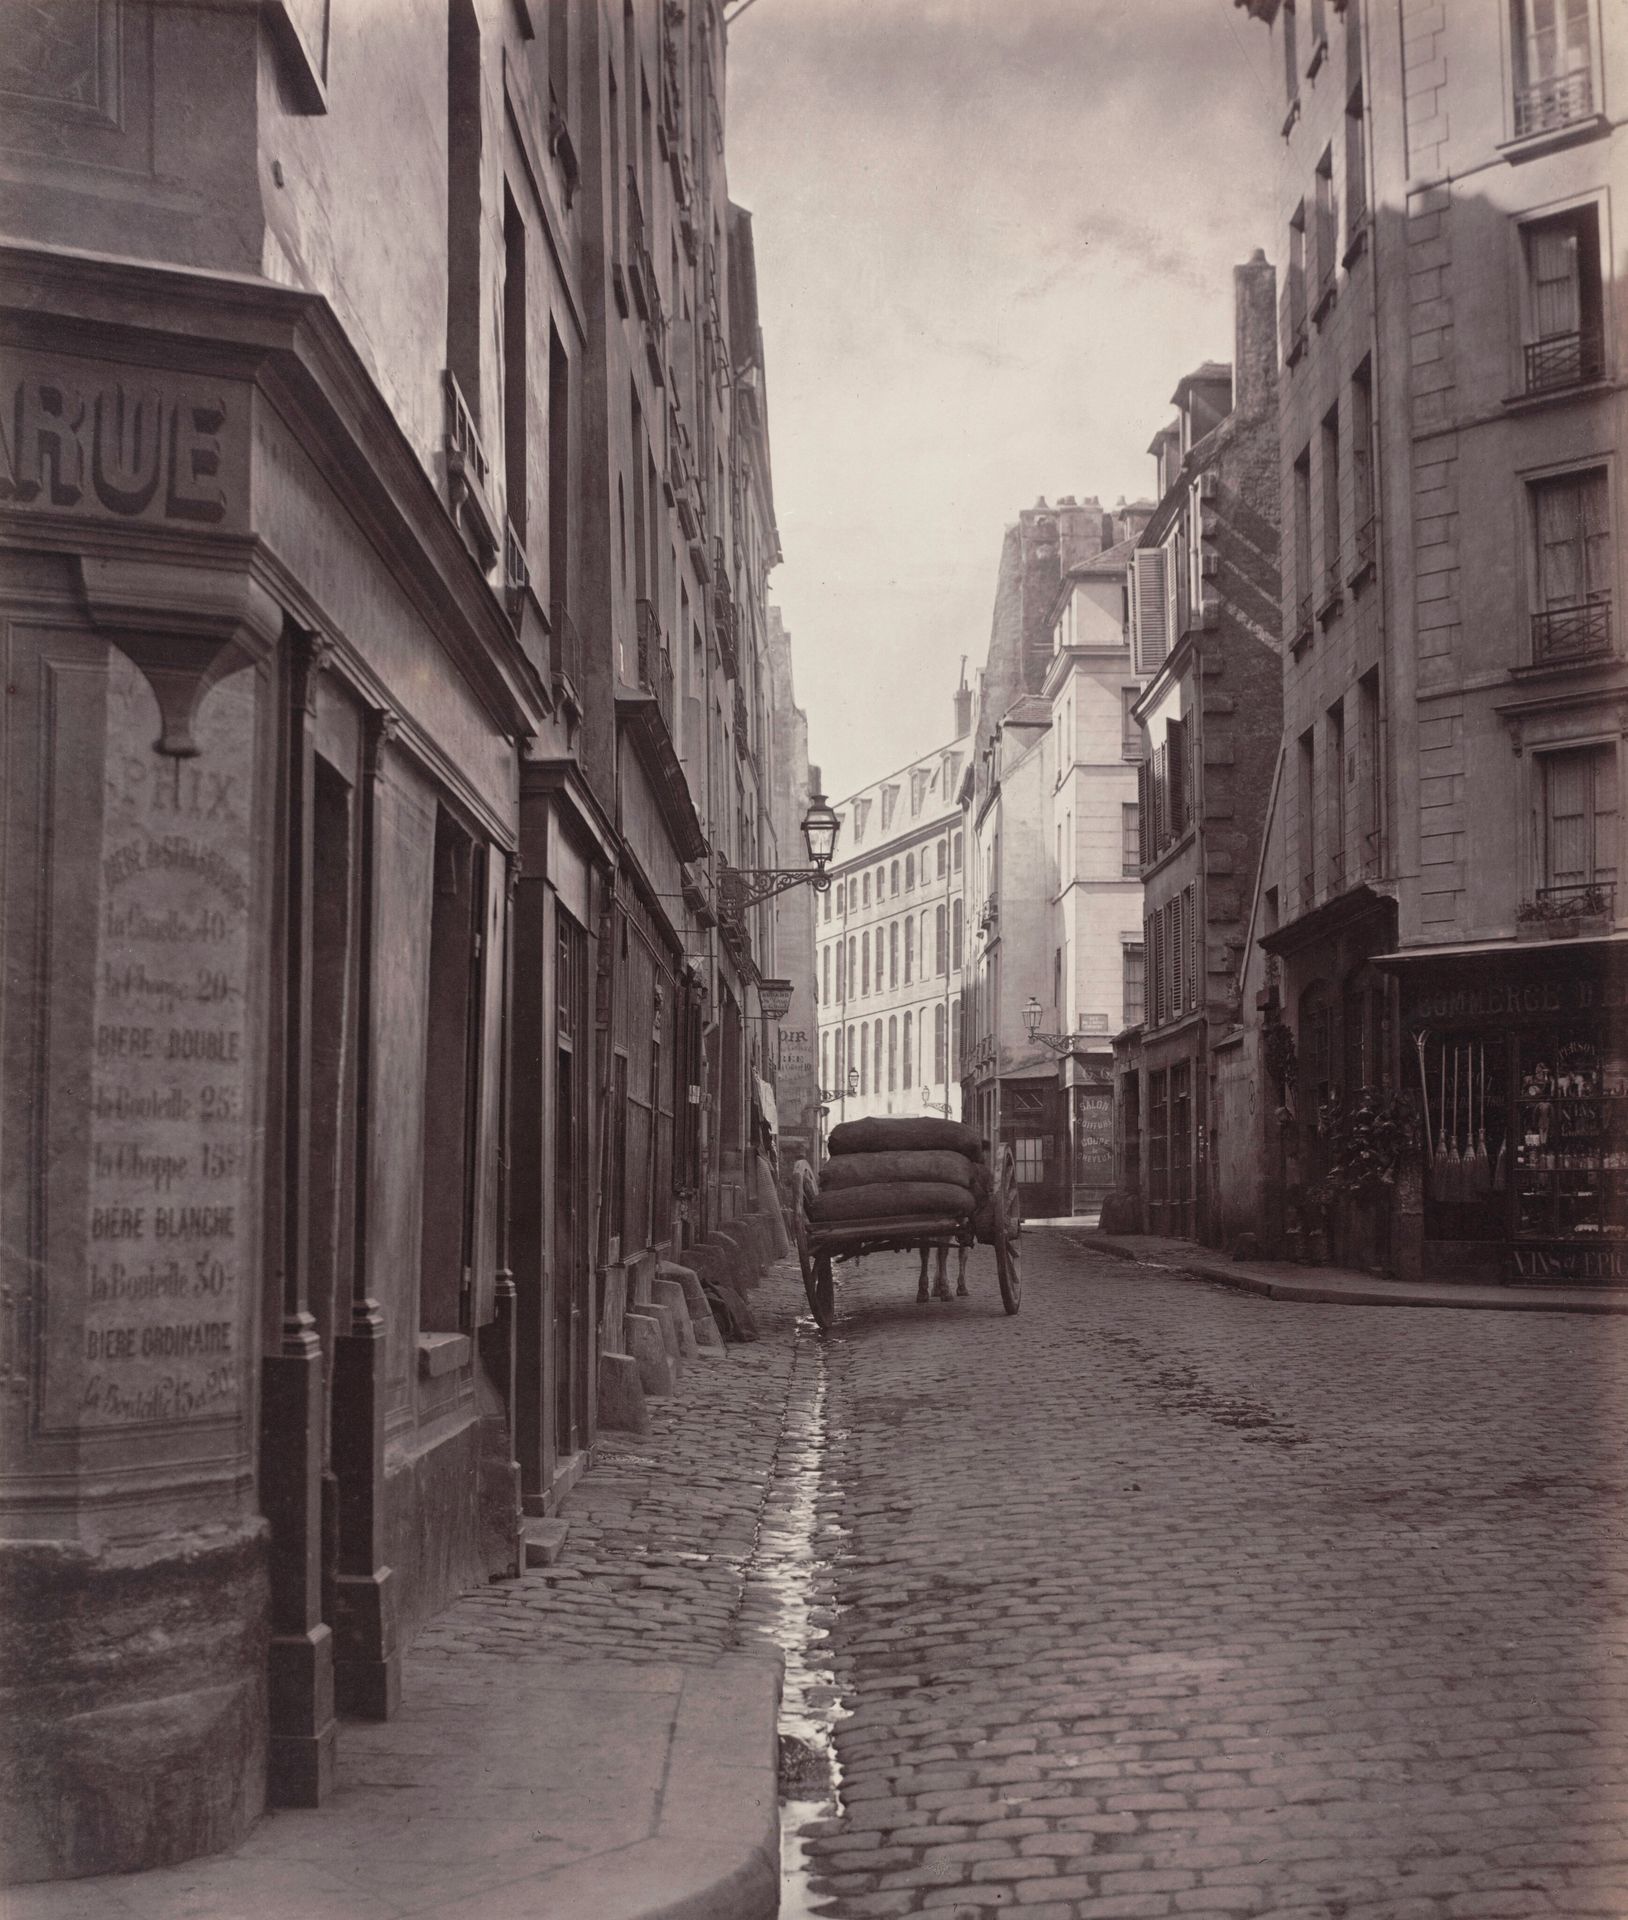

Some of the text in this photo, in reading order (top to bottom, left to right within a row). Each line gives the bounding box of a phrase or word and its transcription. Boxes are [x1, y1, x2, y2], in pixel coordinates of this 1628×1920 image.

[167, 1027, 240, 1063] DOUBLE
[1079, 1099, 1110, 1111] SALON
[155, 1206, 235, 1241] BLANCHE
[141, 1321, 232, 1358] ORDINAIRE
